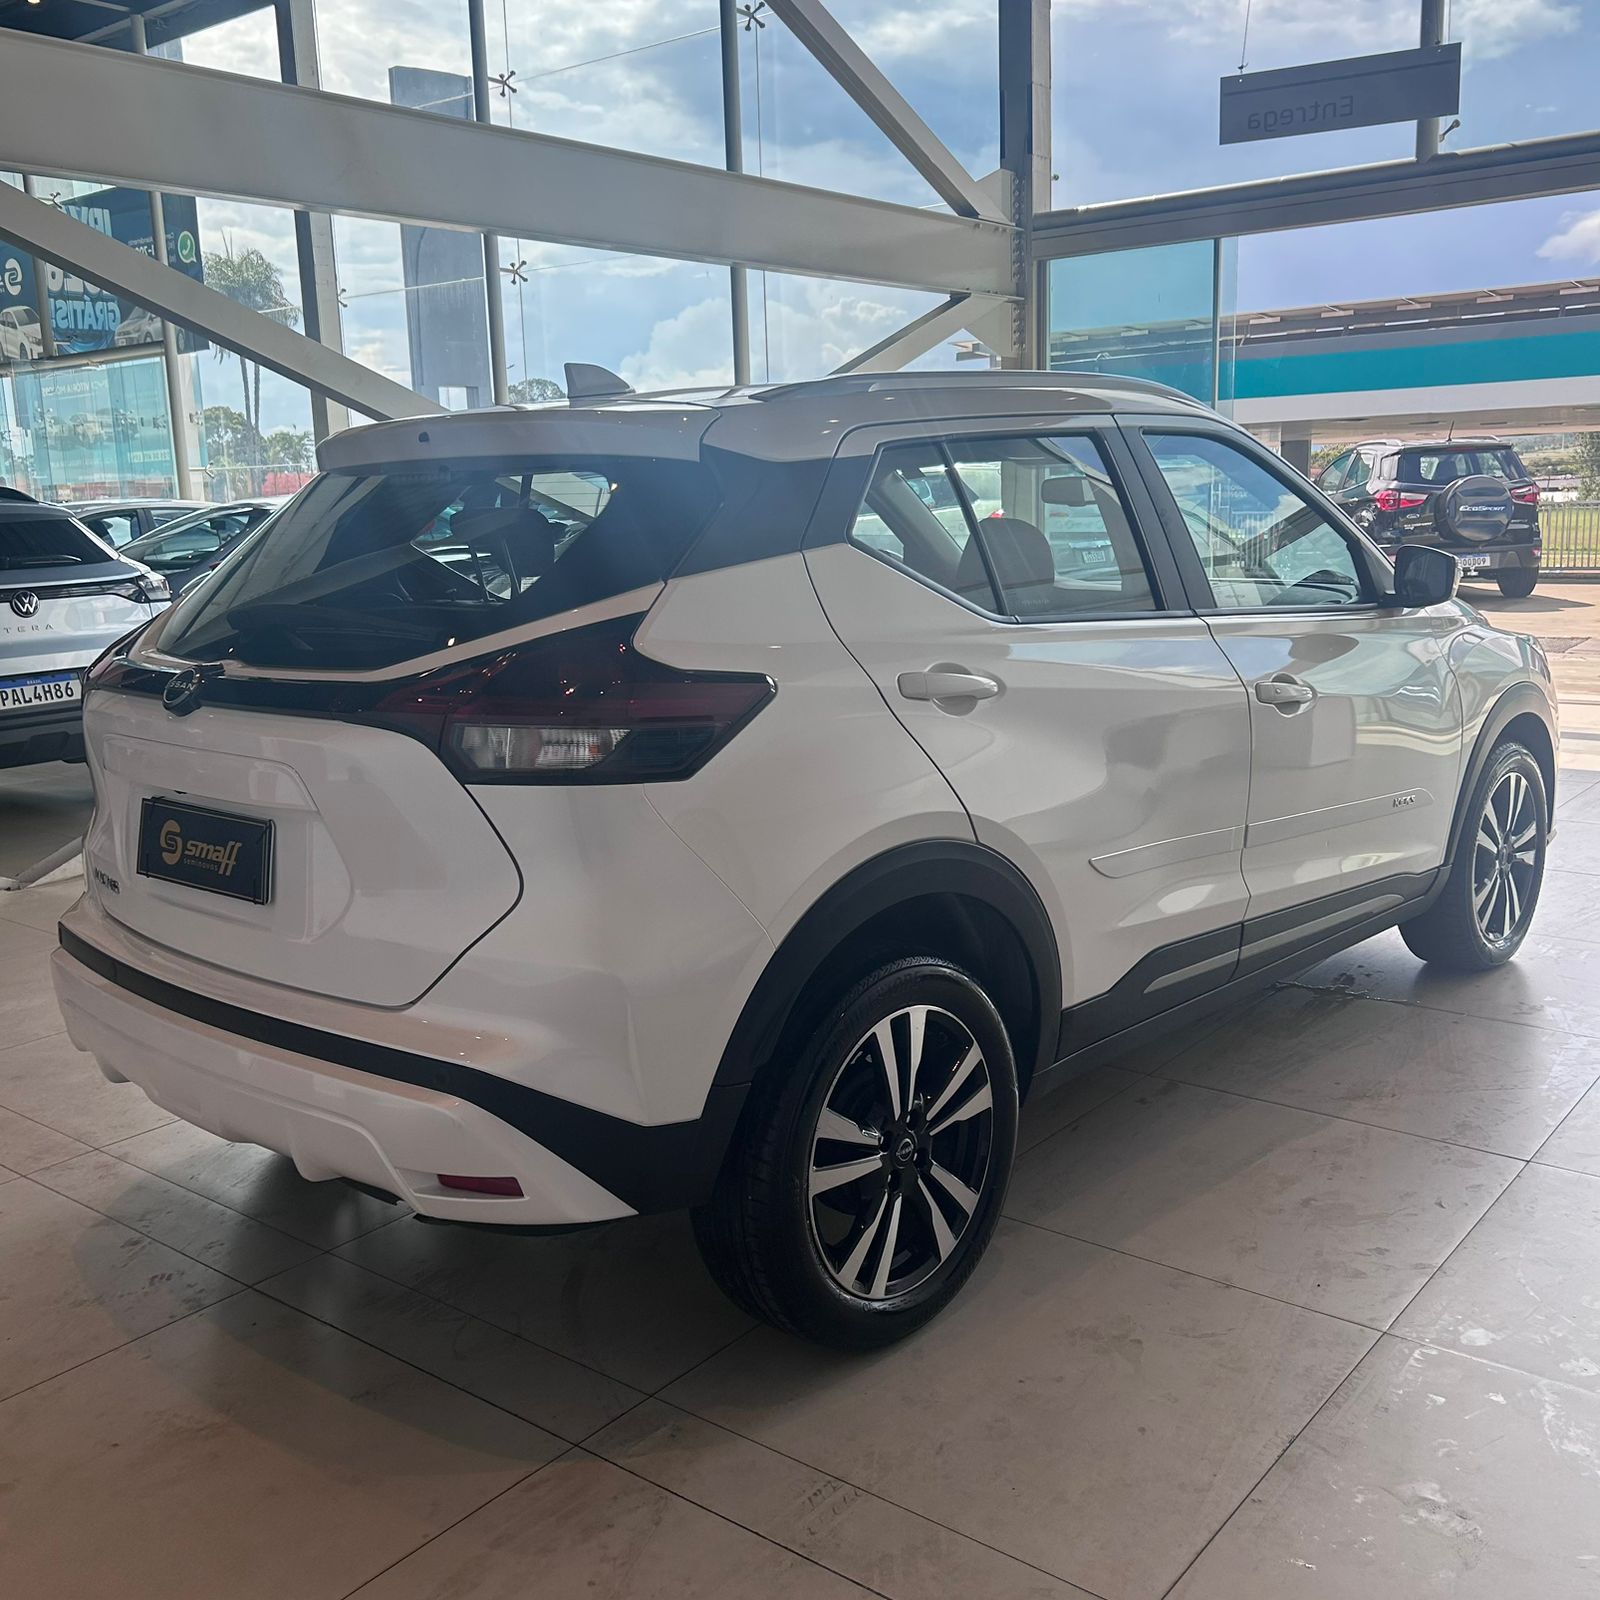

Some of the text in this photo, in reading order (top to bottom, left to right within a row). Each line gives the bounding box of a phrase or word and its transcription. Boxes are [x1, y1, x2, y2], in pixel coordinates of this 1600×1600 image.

[3, 624, 54, 634] TERA
[0, 681, 74, 706] PAL4H86
[184, 840, 243, 876] smaff
